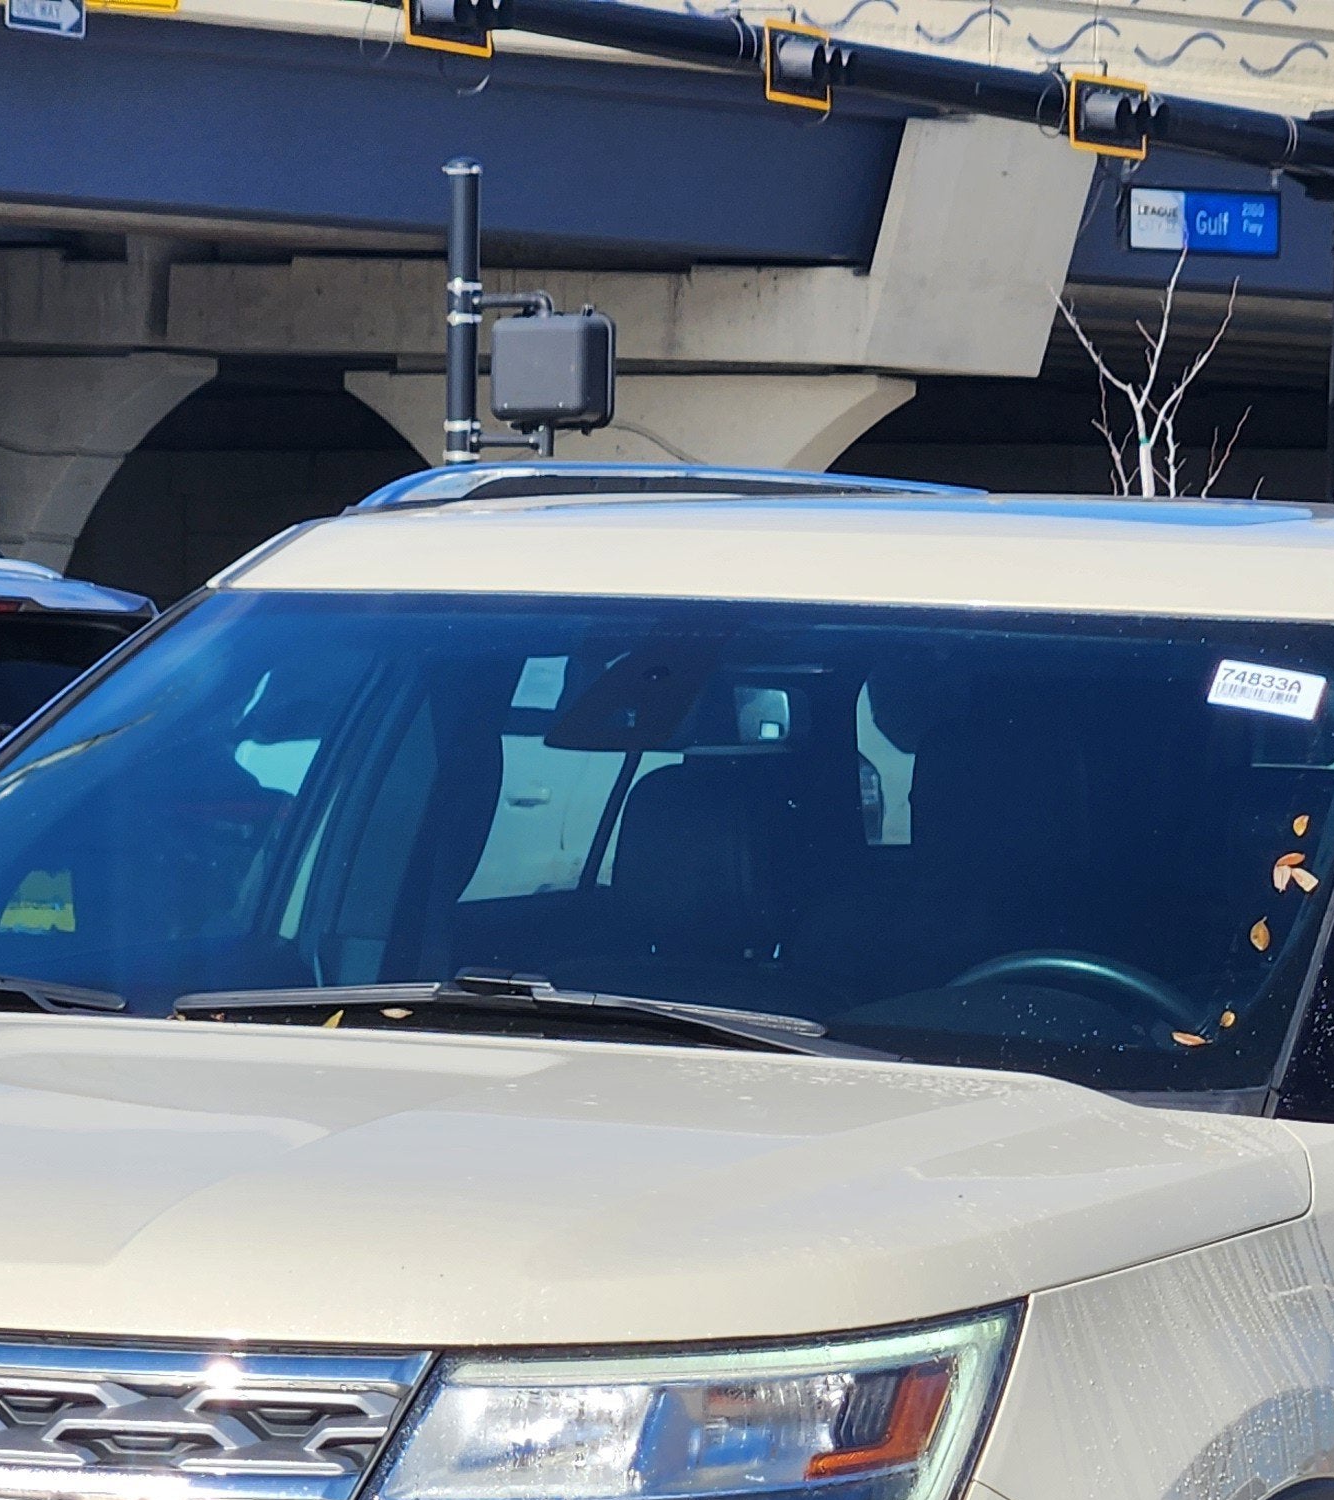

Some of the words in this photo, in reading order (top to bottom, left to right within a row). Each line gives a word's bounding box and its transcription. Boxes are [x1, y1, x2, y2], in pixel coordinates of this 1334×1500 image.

[1137, 204, 1179, 217] LEAGUE
[1195, 210, 1230, 236] Gulf
[1221, 667, 1303, 694] 74833A
